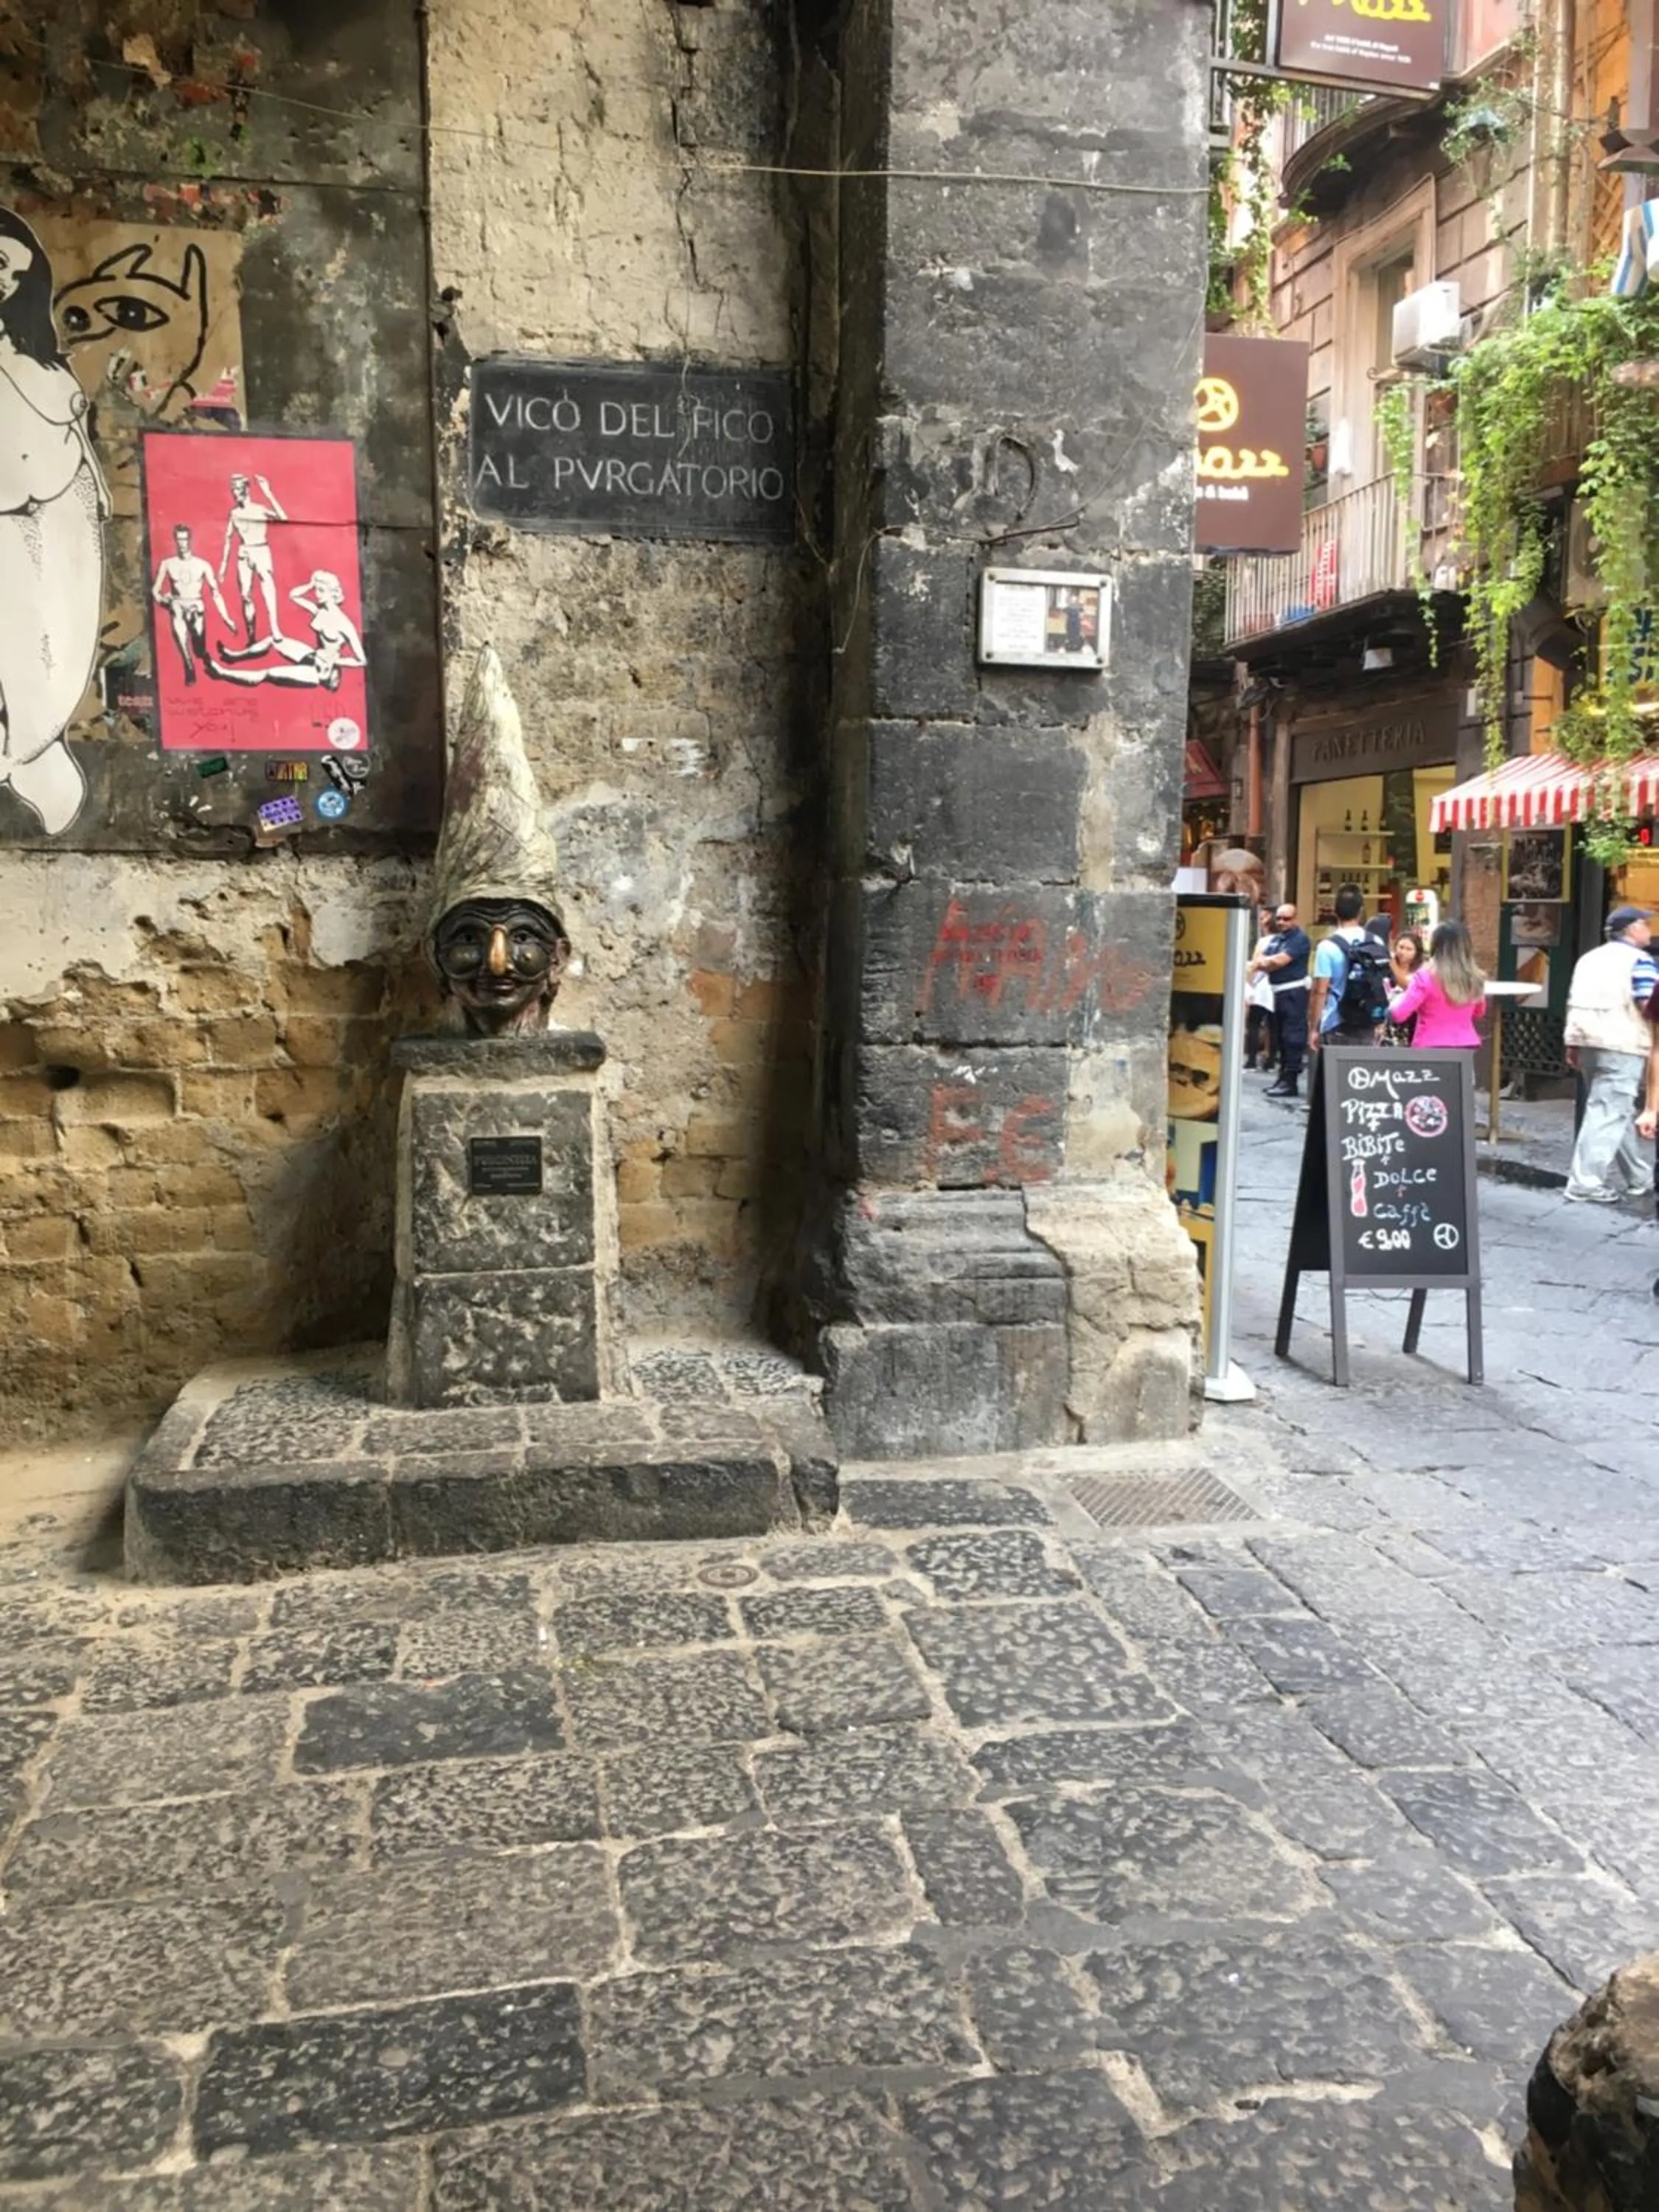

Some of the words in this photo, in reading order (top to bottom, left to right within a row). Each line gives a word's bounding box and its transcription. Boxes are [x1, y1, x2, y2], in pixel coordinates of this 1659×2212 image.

[599, 400, 675, 438] DEL
[691, 406, 774, 443] FICO
[475, 454, 530, 489] AL
